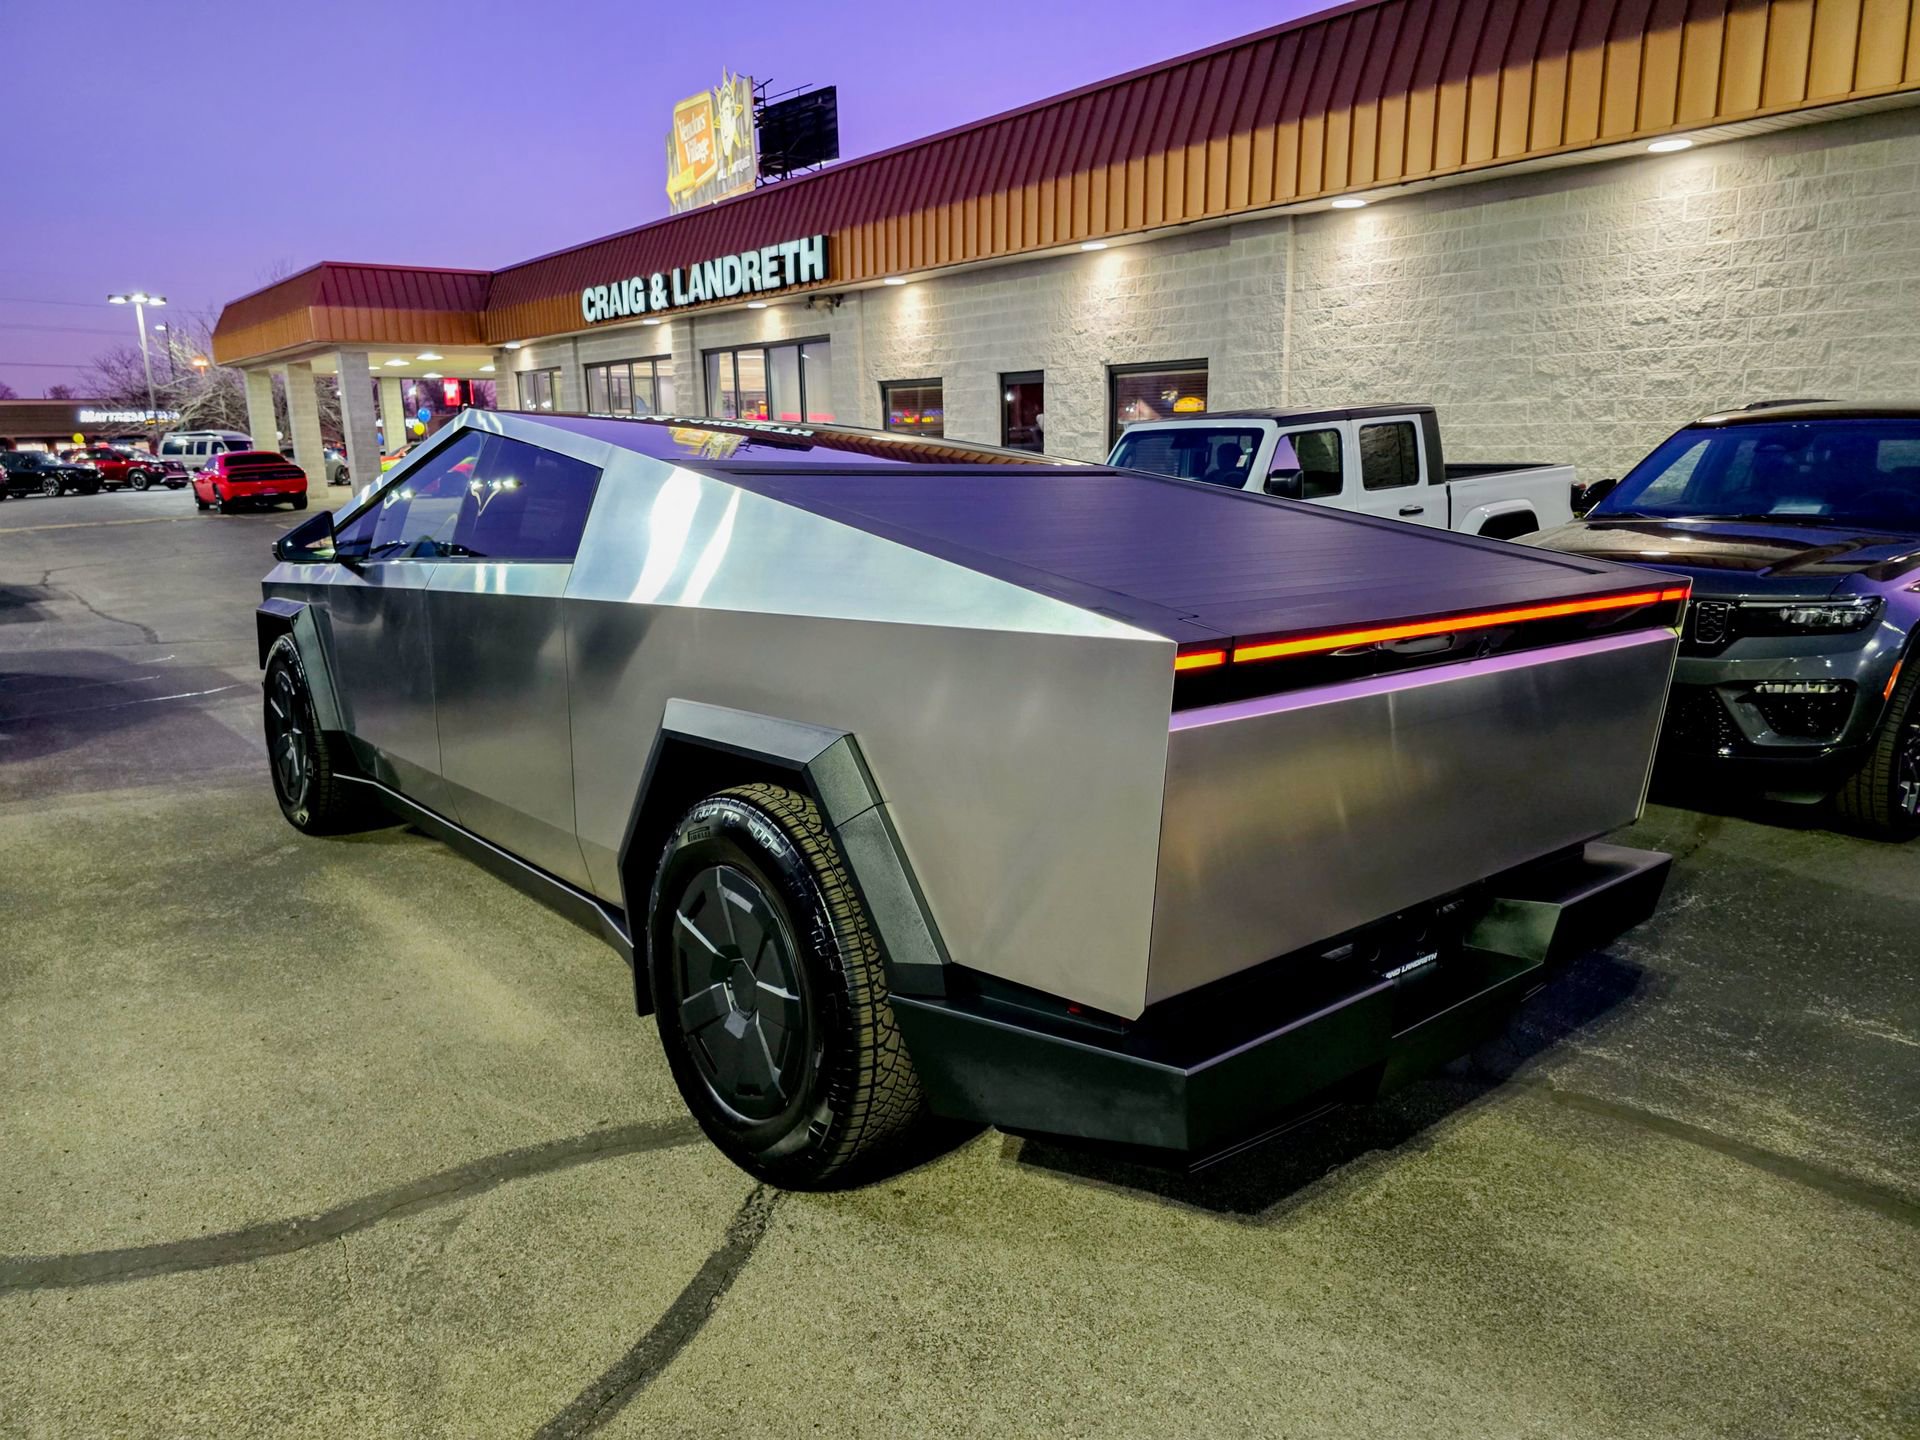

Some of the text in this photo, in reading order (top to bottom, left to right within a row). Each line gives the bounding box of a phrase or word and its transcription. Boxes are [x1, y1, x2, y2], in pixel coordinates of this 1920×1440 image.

[582, 234, 826, 323] CRAIG & LANDRETH
